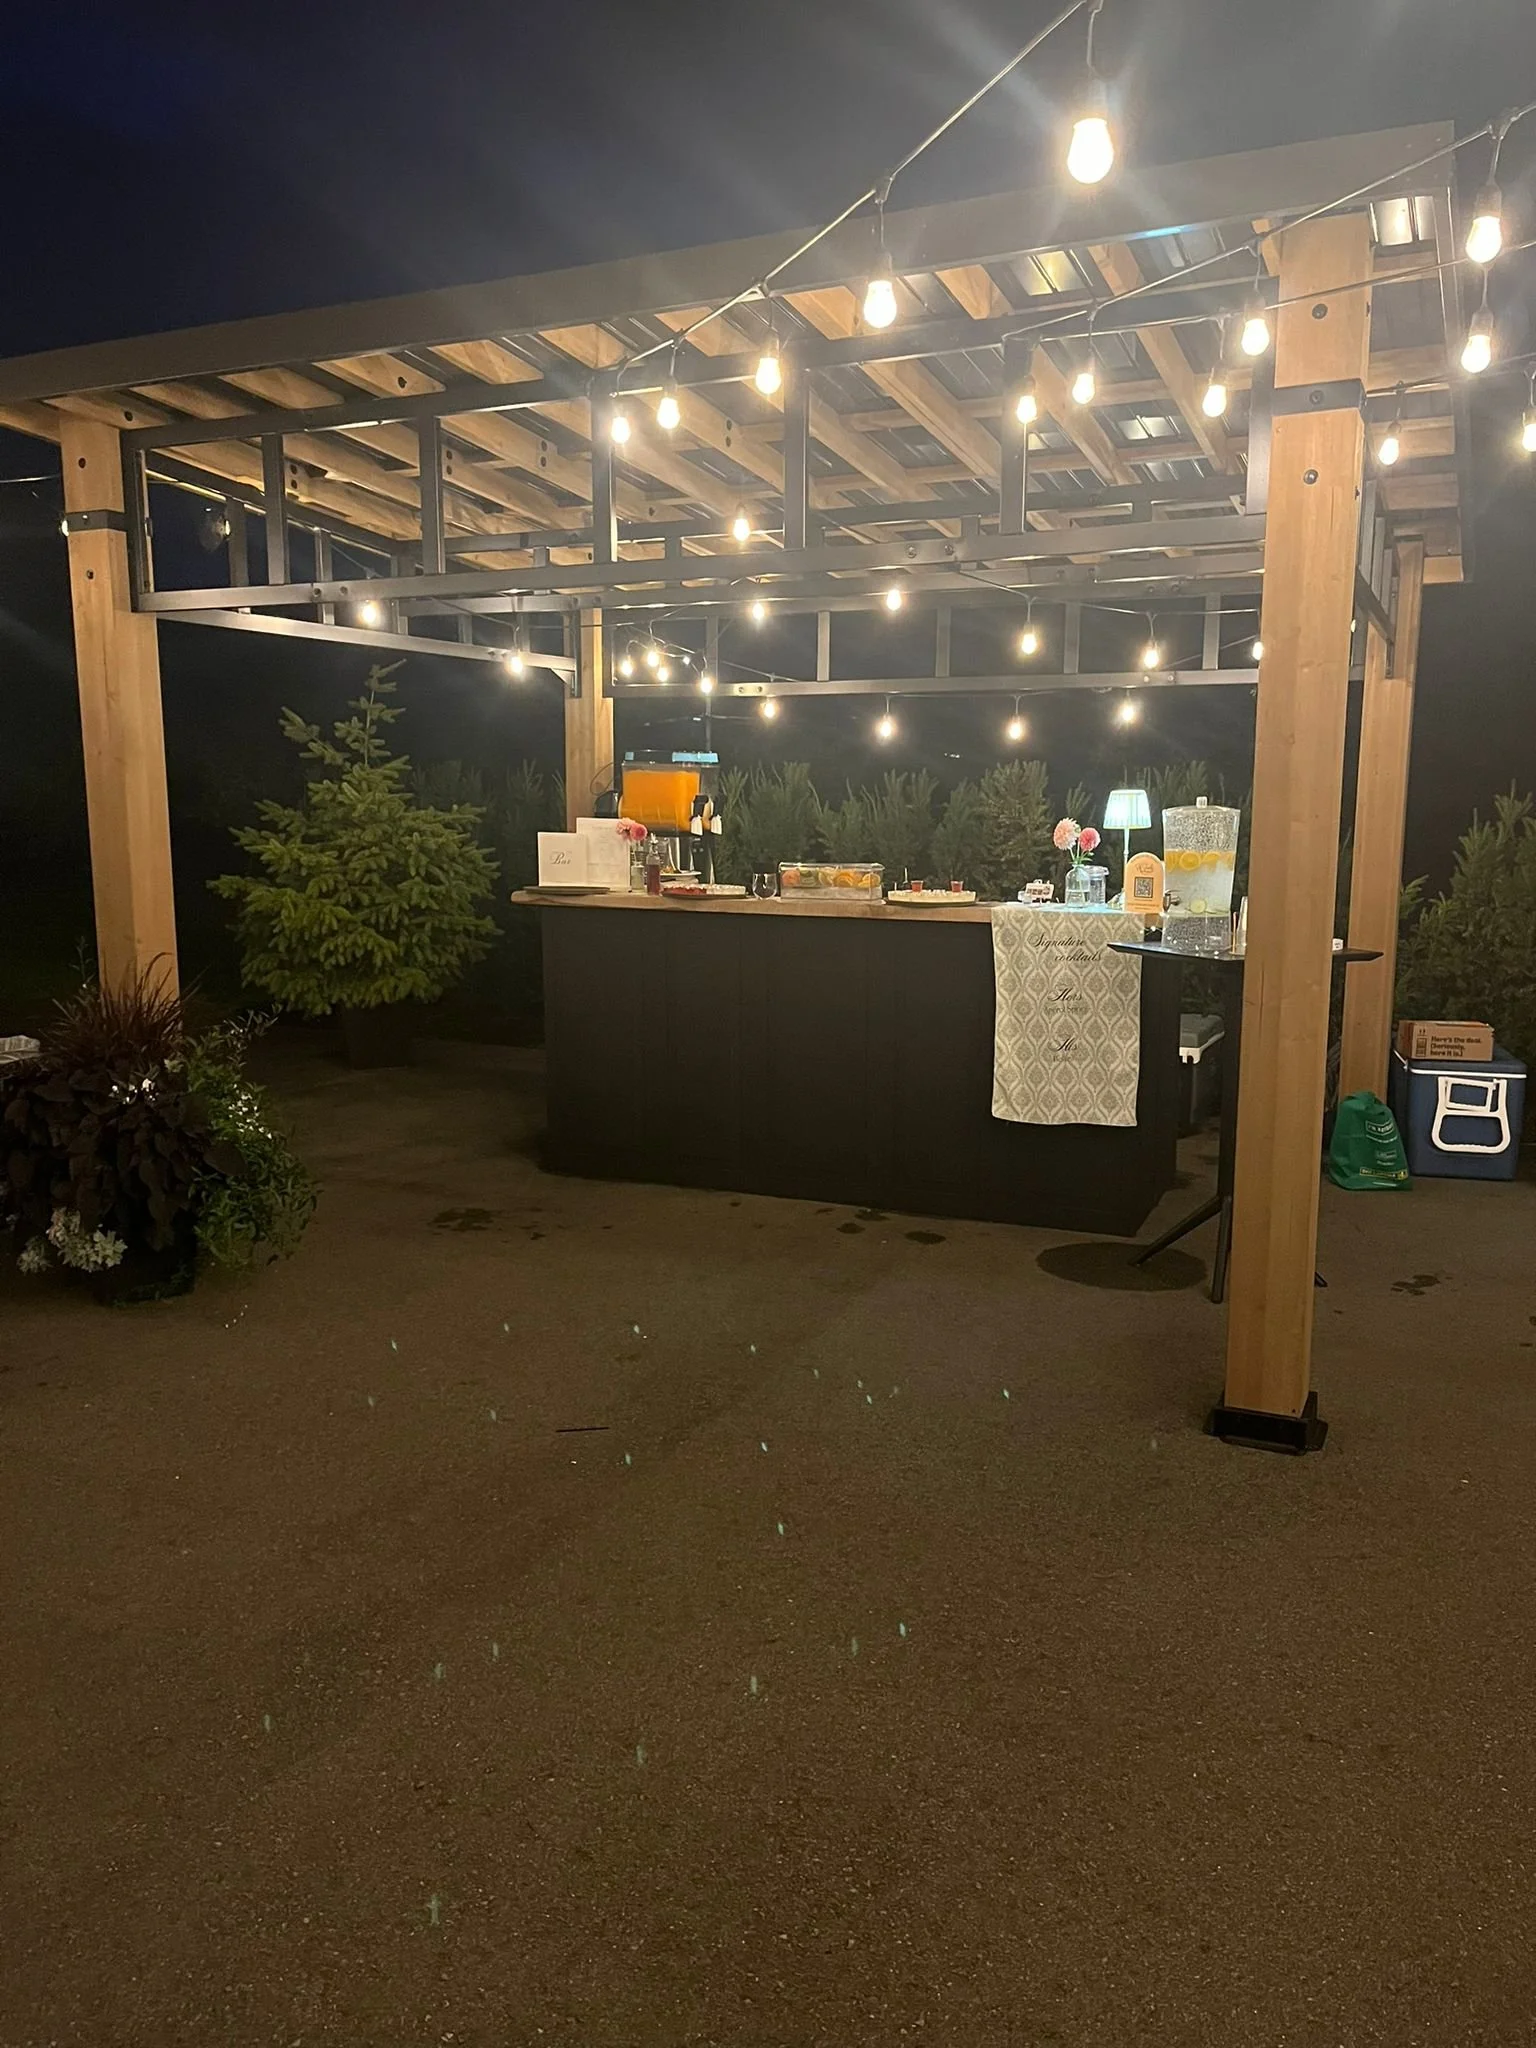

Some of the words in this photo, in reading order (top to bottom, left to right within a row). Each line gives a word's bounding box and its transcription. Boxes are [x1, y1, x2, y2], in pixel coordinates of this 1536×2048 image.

[1027, 932, 1086, 952] Signature
[1055, 949, 1103, 961] cocktails
[1048, 1034, 1077, 1051] His
